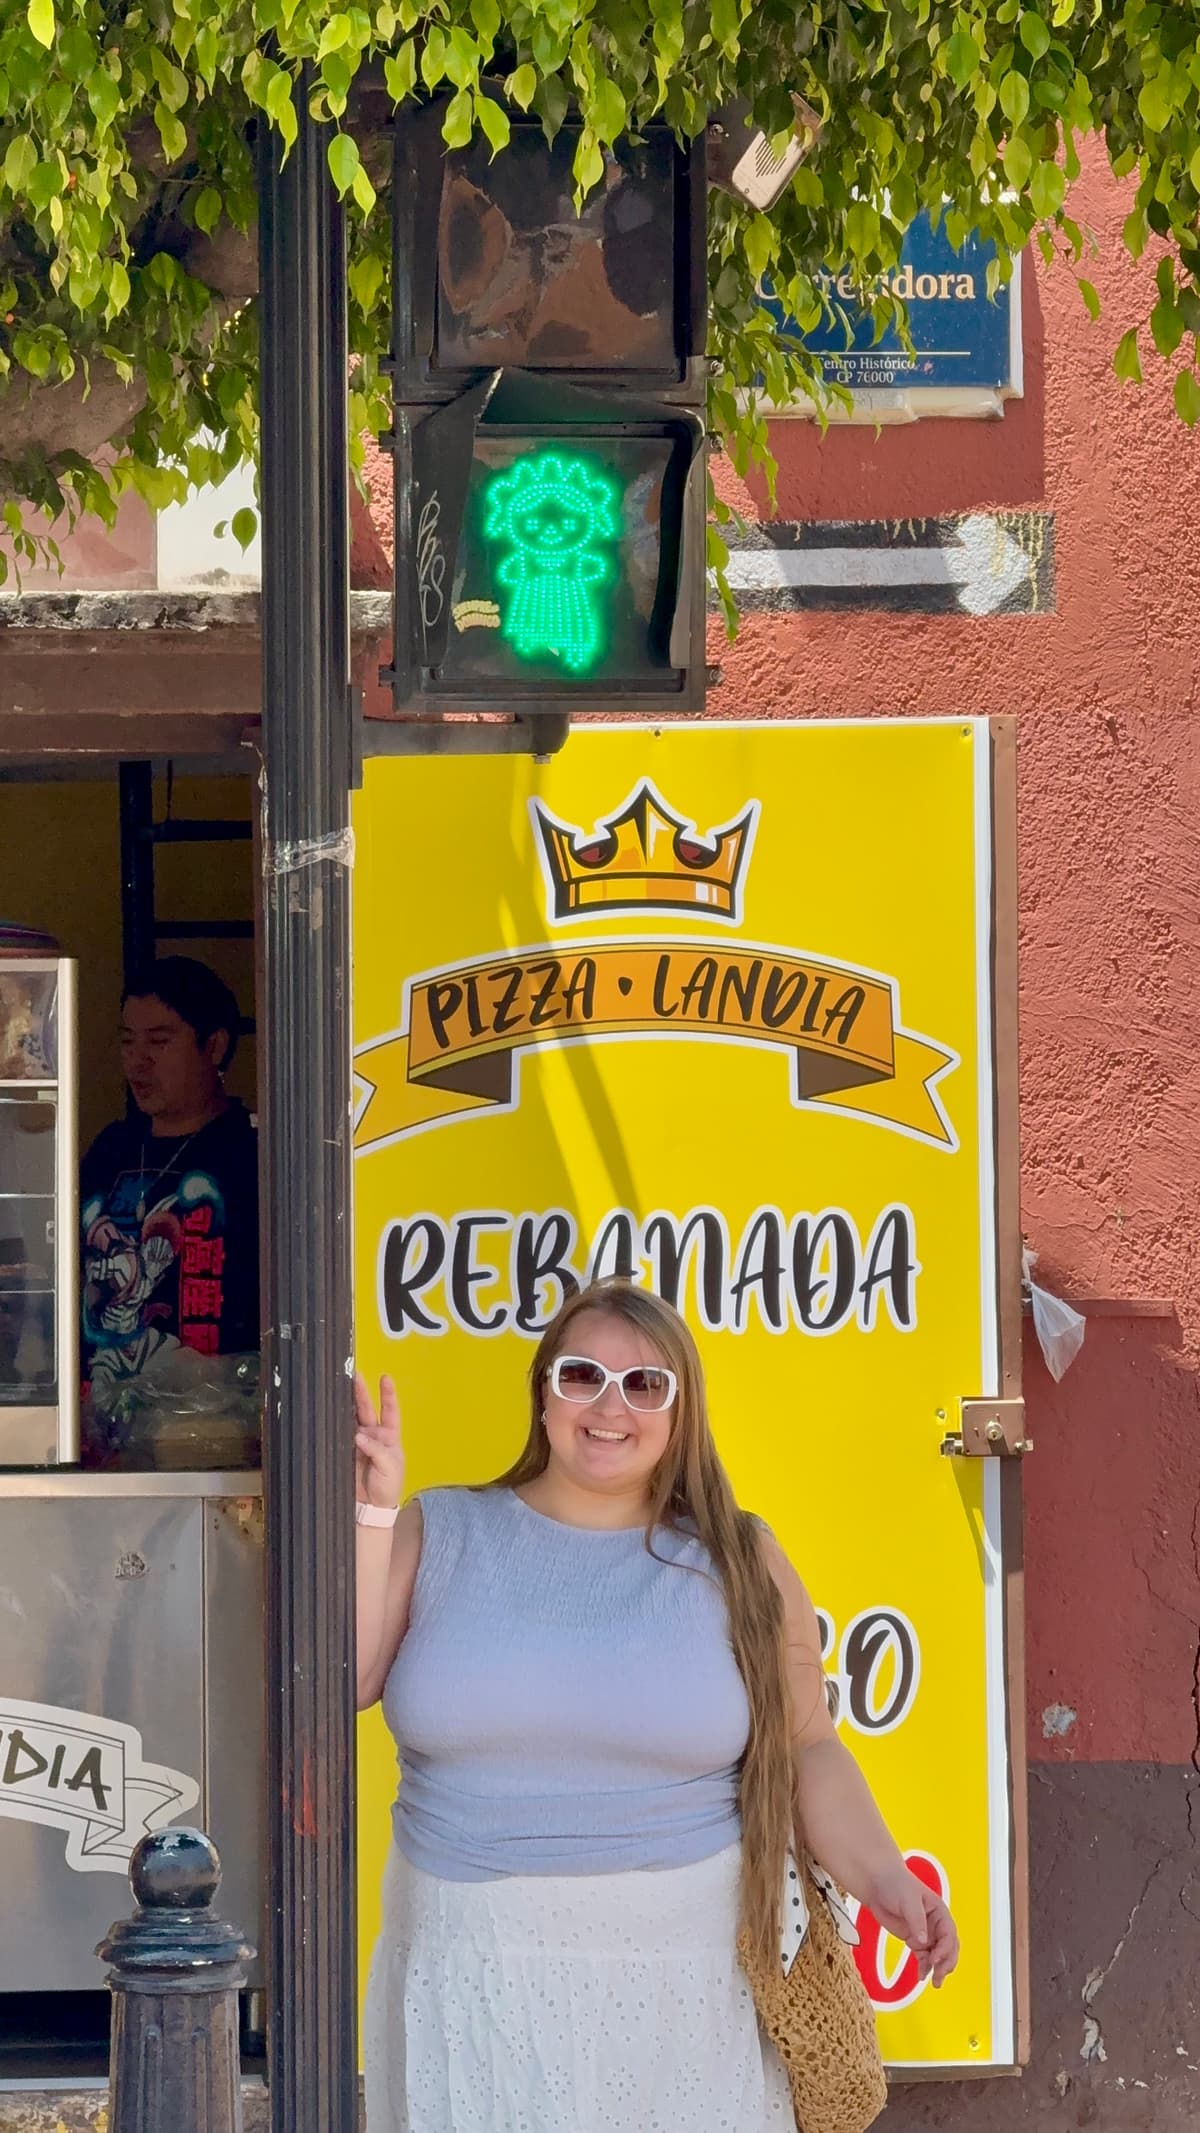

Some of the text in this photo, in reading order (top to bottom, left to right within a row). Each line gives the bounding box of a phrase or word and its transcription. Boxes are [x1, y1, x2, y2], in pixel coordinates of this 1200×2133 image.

[836, 371, 894, 384] CP 76000
[860, 356, 915, 370] Histórico
[427, 954, 866, 1049] PIZZA LANDIA
[384, 1209, 916, 1333] REBANADA
[0, 1729, 112, 1811] DIA
